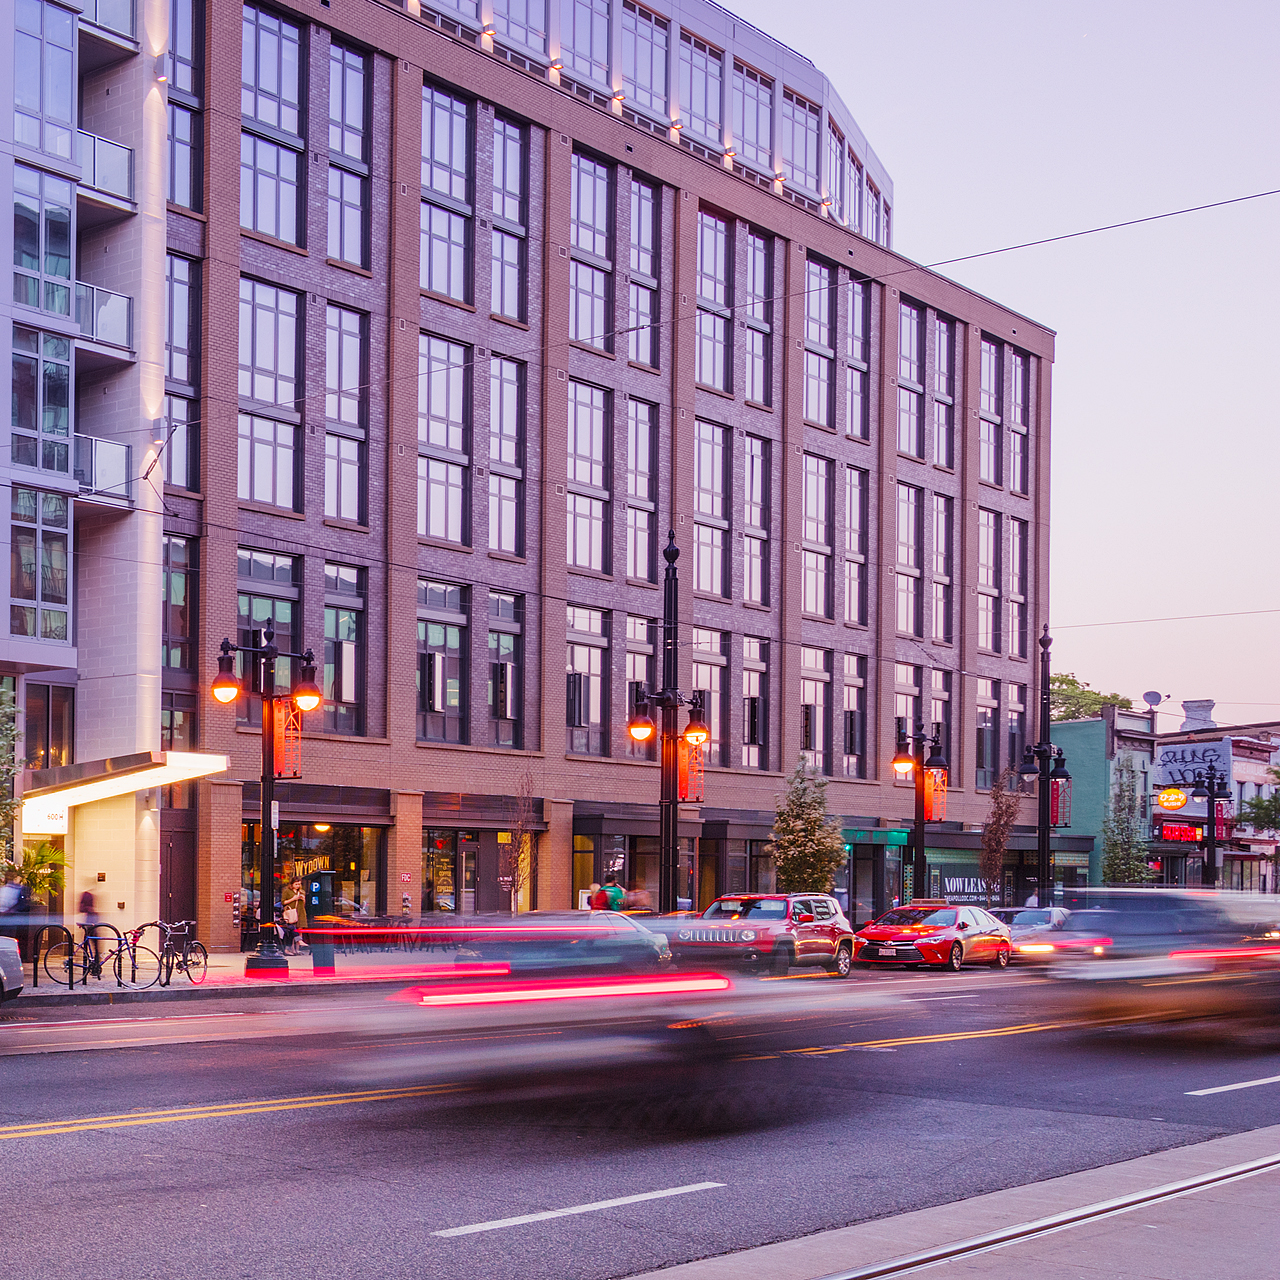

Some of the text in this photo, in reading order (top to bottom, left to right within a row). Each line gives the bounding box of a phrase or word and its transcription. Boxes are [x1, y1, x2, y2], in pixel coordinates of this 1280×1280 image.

[1160, 793, 1185, 801] ひかり
[295, 856, 330, 876] WYDOWN
[402, 874, 411, 882] FDC
[944, 877, 964, 893] NOW
